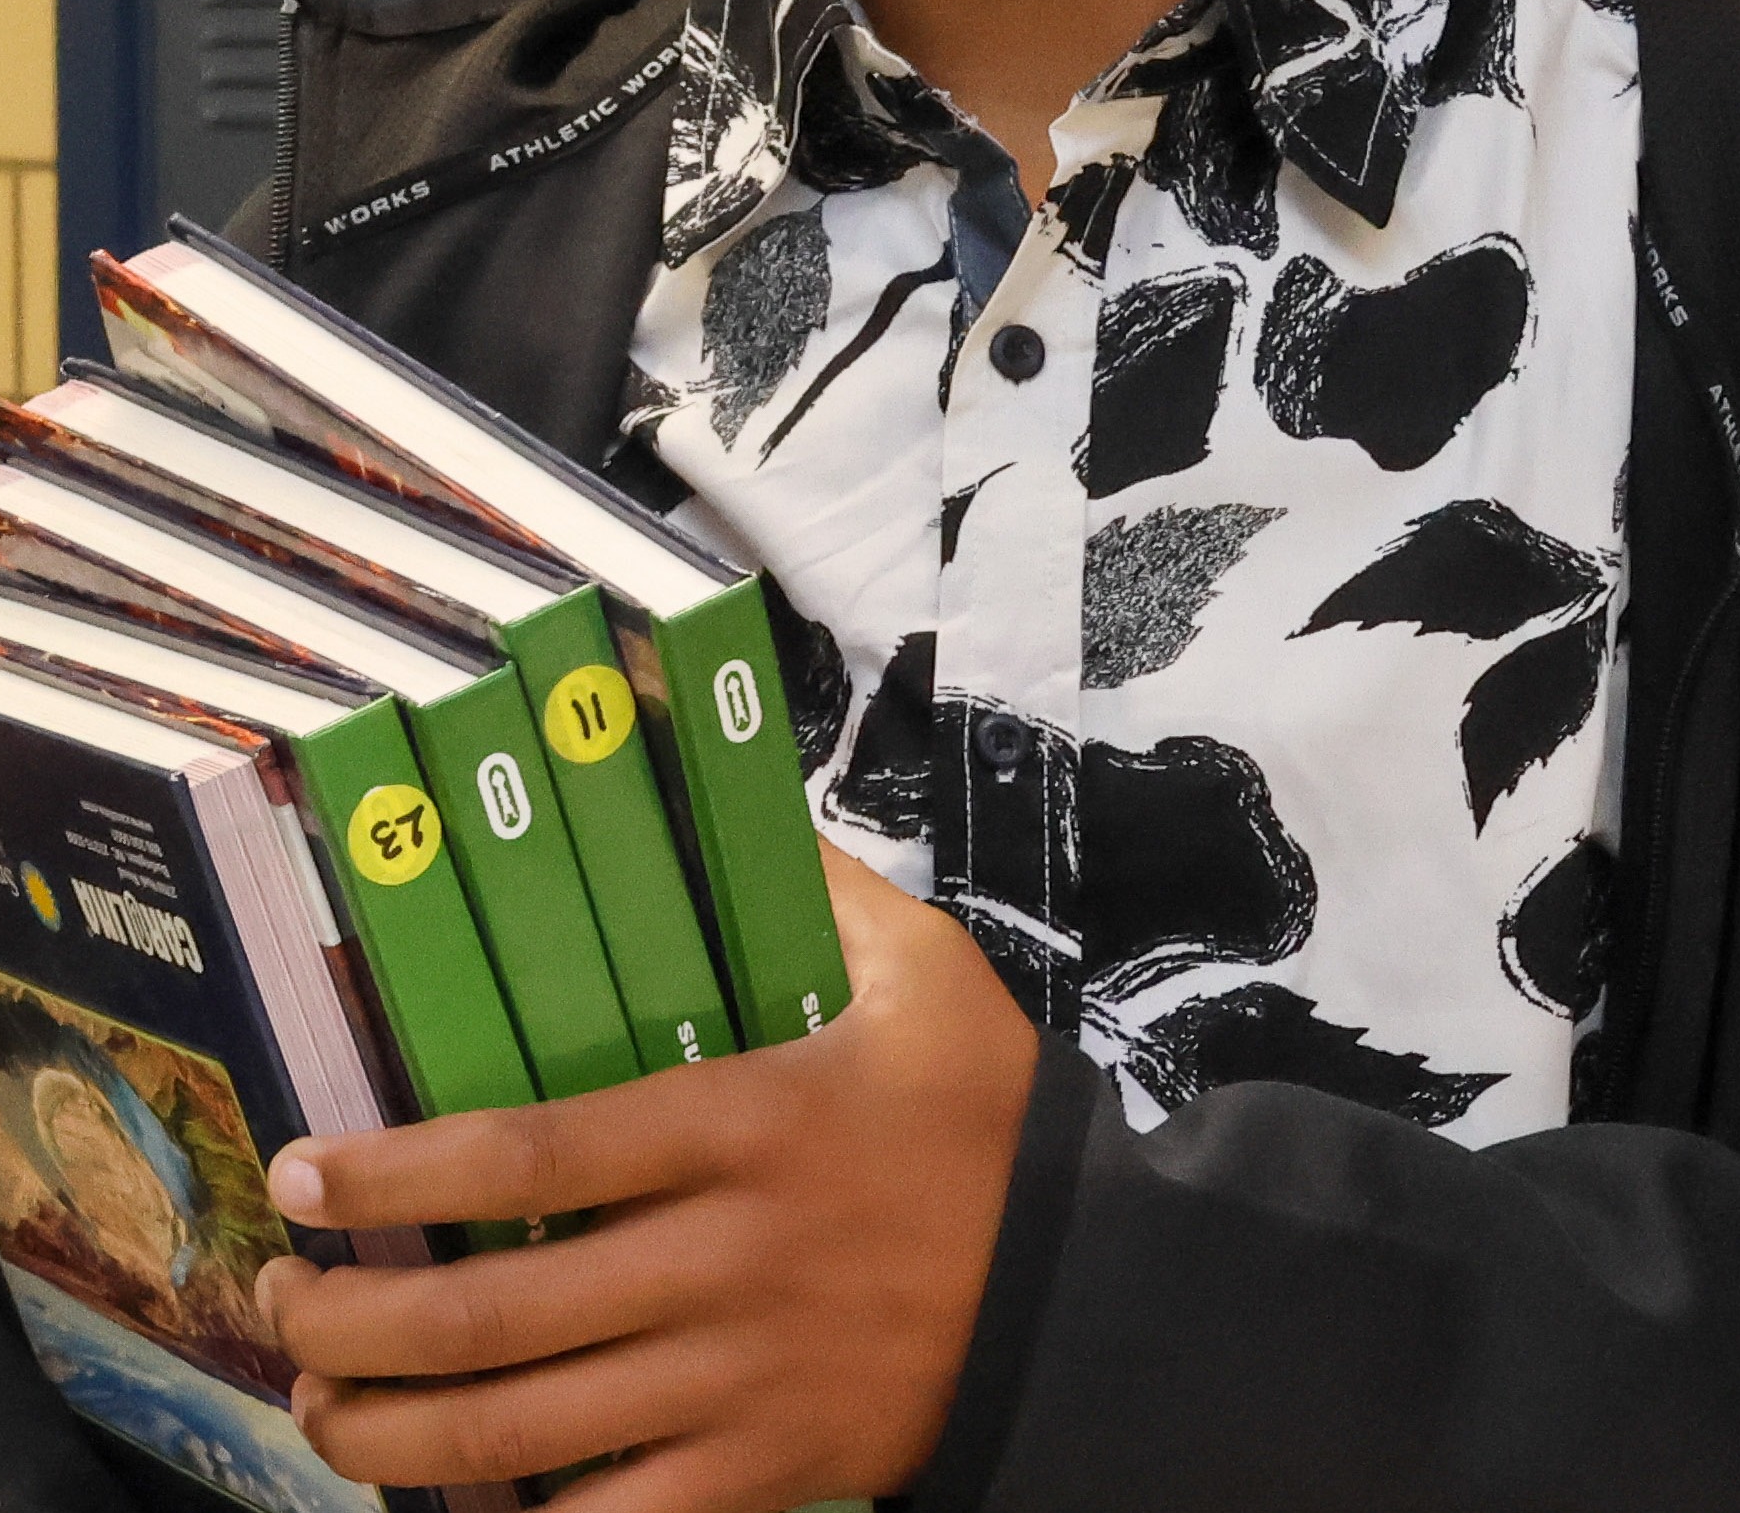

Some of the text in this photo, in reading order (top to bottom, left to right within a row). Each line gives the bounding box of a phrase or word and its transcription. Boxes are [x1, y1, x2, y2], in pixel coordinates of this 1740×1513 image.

[323, 179, 432, 235] WORKS
[489, 96, 619, 173] ATHLETIC
[571, 691, 608, 740] 11
[71, 876, 204, 975] CAROLINA
